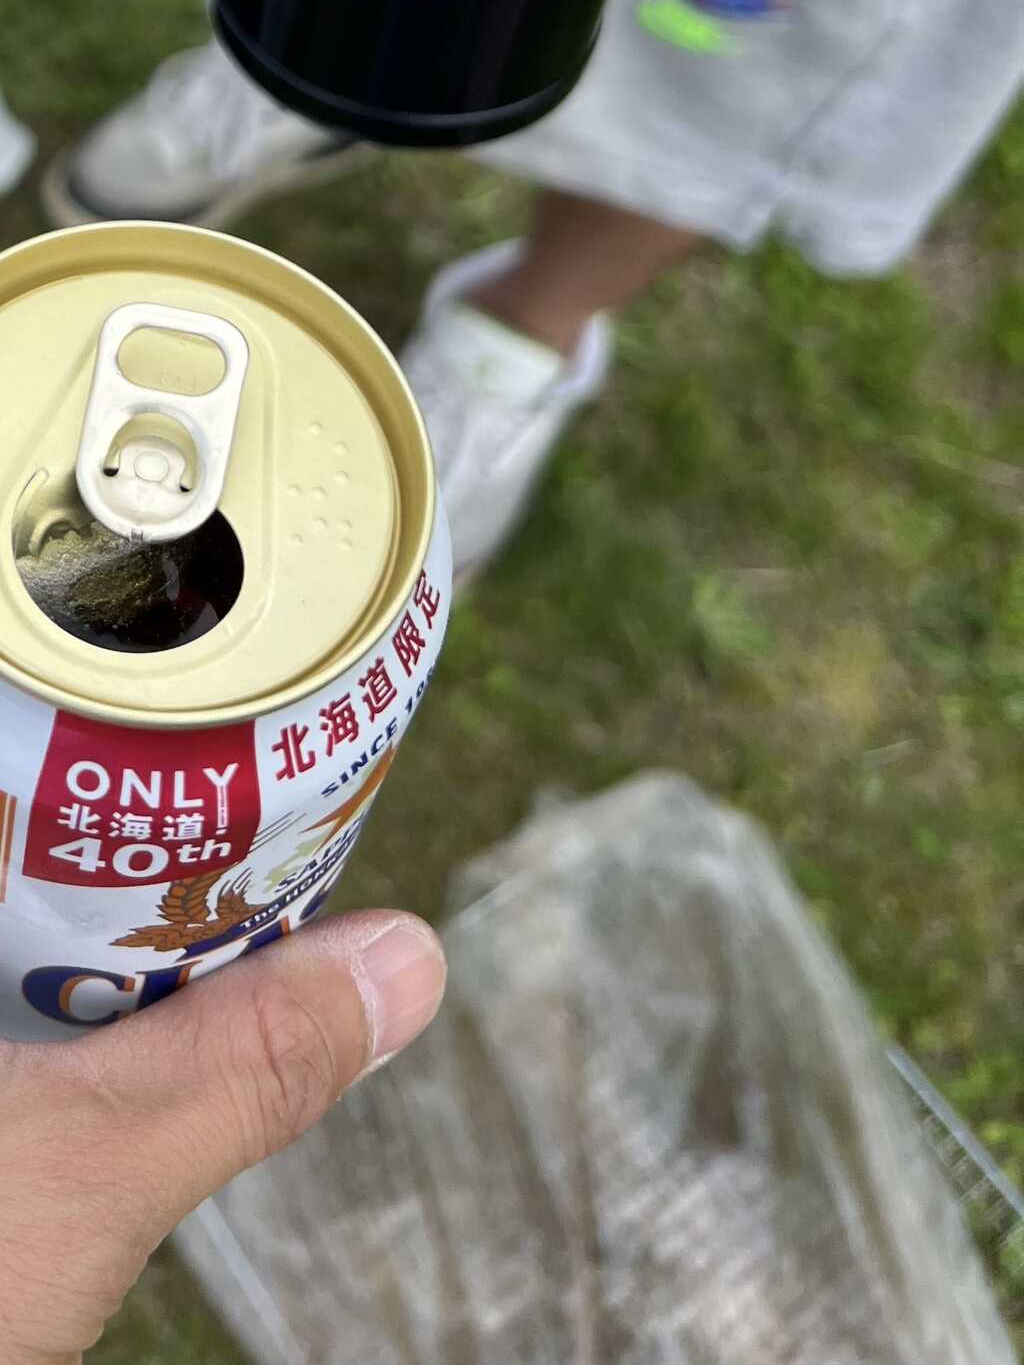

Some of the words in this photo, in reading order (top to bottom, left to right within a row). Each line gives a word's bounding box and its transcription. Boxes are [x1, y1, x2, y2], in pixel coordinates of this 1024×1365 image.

[272, 569, 440, 781] 北海道限定
[321, 717, 398, 798] SINCE
[48, 837, 232, 879] 40th
[239, 903, 280, 929] The
